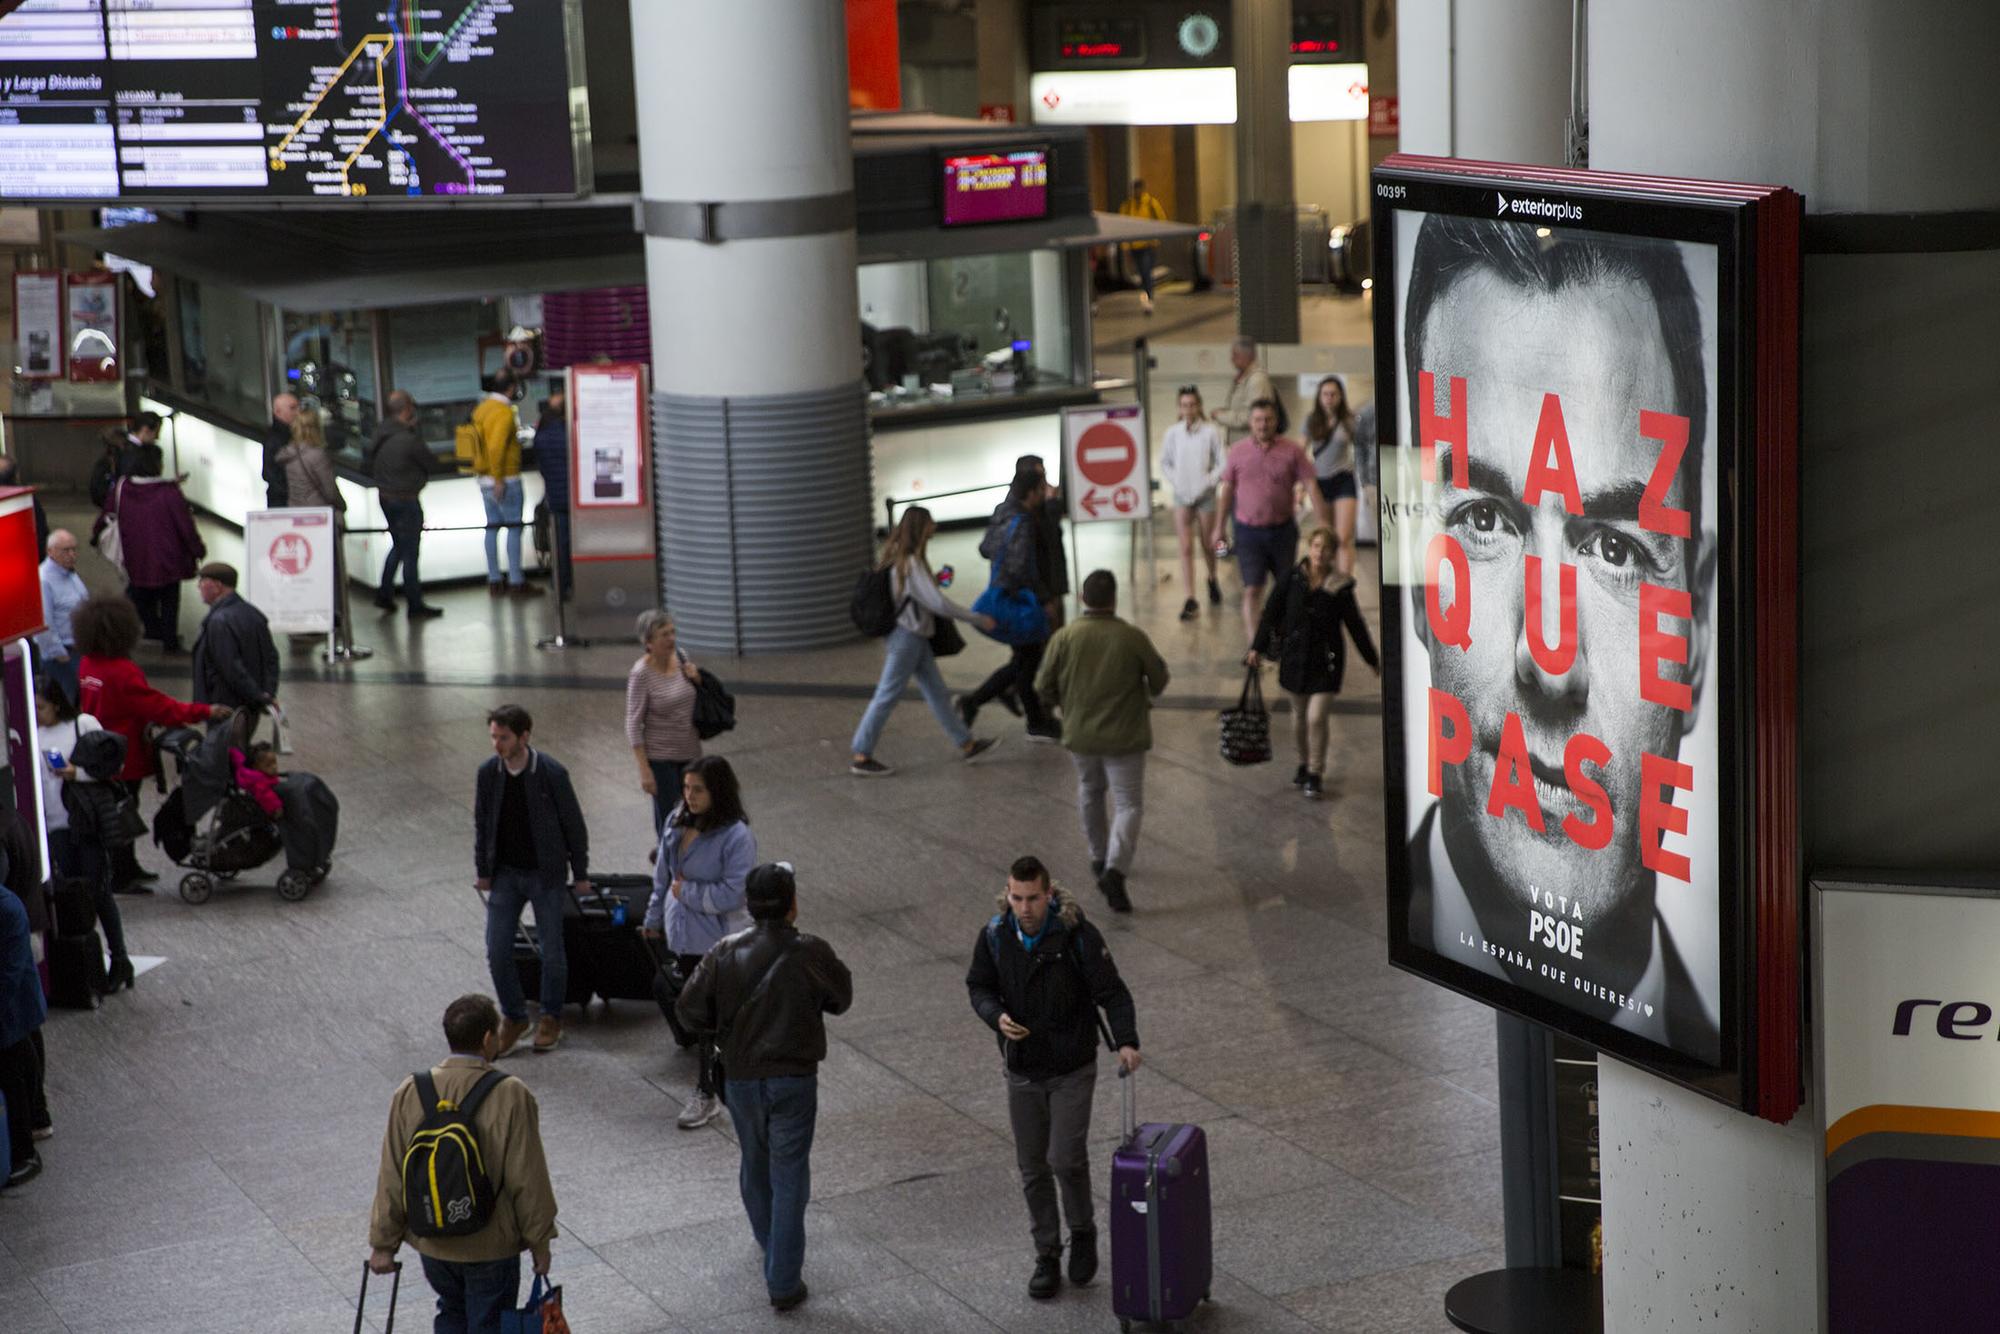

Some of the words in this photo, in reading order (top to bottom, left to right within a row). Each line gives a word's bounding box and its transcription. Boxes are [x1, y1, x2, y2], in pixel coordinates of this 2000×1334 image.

[14, 75, 46, 94] Larga
[48, 74, 102, 91] Distancia
[1377, 183, 1407, 199] 00395
[1511, 198, 1583, 221] exteriorplus
[1418, 370, 1691, 539] HAZ
[1423, 533, 1694, 714] QUE
[1428, 686, 1695, 884] PASE
[1530, 885, 1583, 921] VOTA
[1460, 931, 1475, 948] LA
[1482, 940, 1533, 972] ESPAÑA
[1541, 964, 1566, 984] QUE
[1529, 910, 1584, 961] PSOE
[1892, 999, 2000, 1041] re
